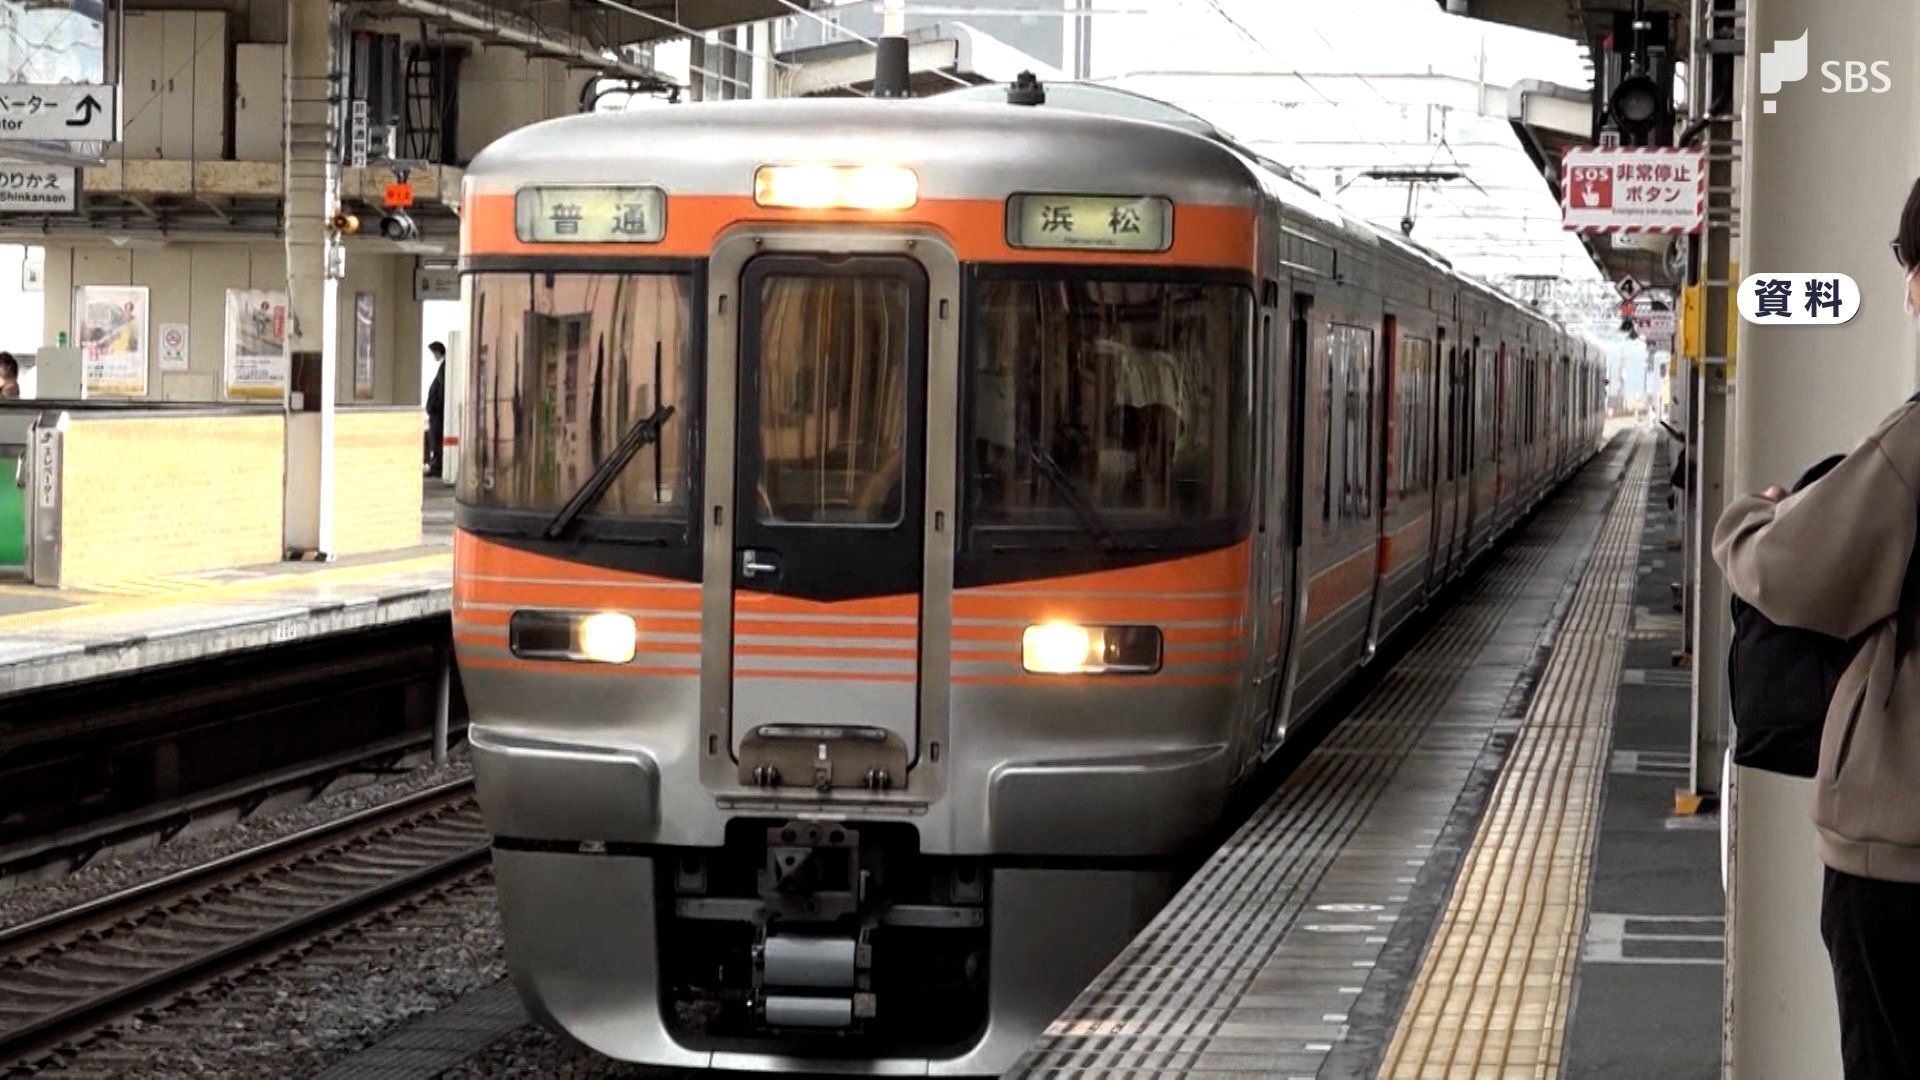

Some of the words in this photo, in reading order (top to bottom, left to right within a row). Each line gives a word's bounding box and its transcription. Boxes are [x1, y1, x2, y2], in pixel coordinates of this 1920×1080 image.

[1575, 168, 1609, 182] SOS
[1616, 163, 1691, 182] 非常停止
[1626, 185, 1680, 202] ボタン
[549, 202, 647, 235] 普通
[1041, 206, 1141, 234] 浜松
